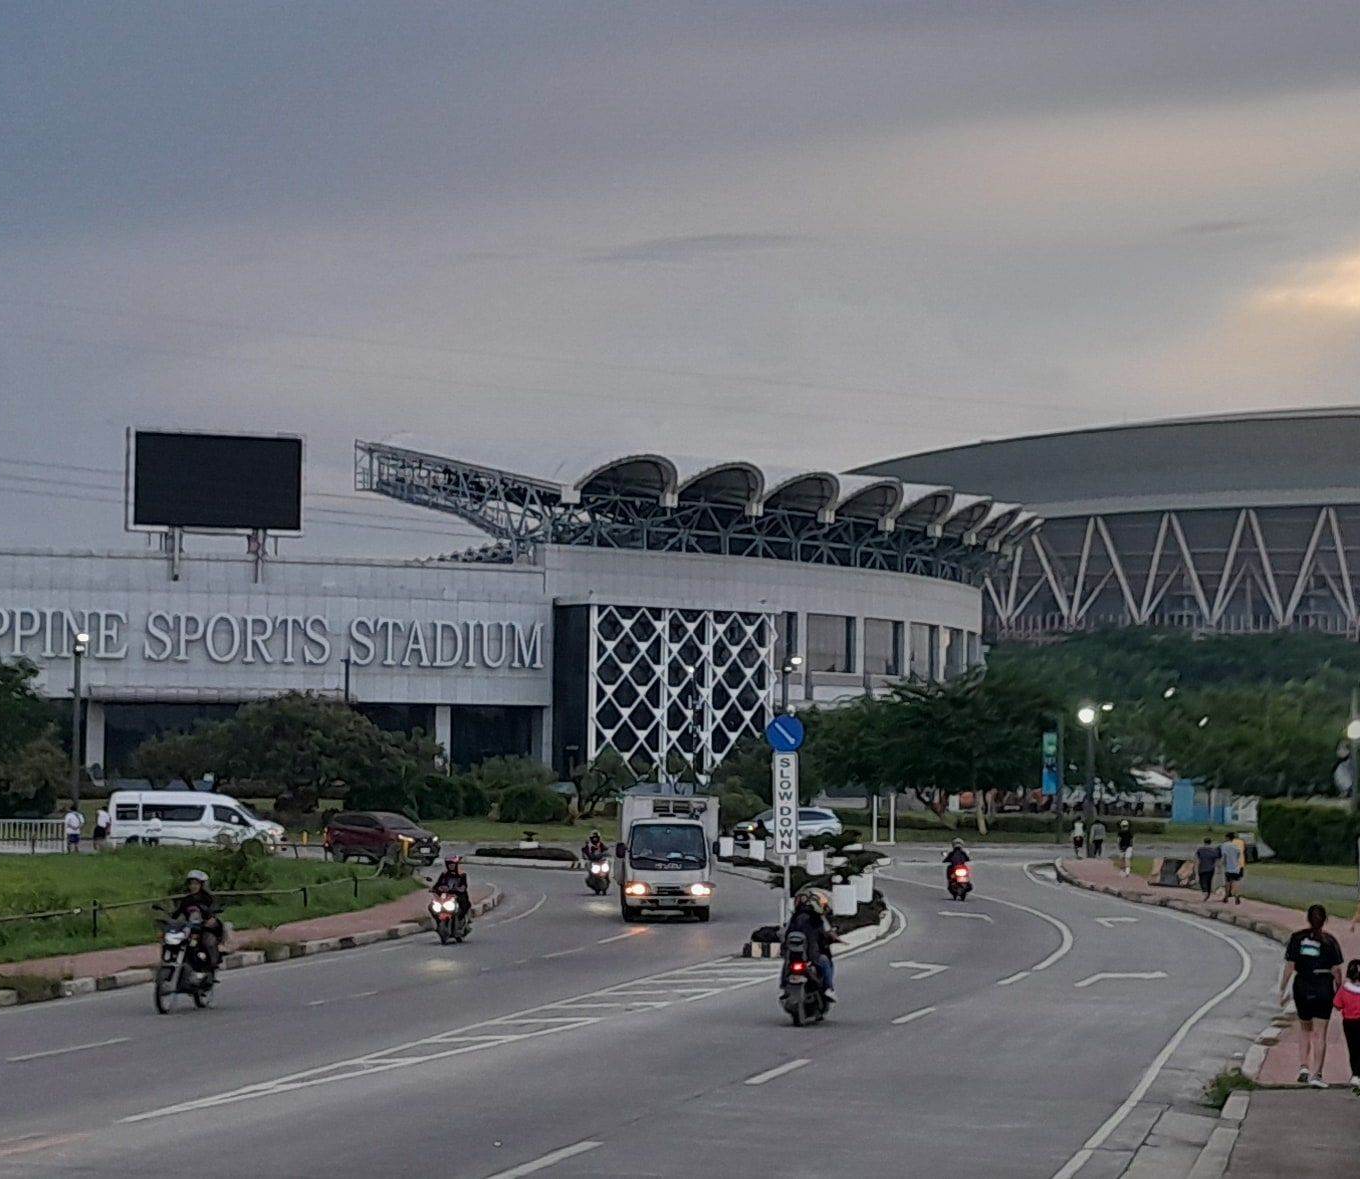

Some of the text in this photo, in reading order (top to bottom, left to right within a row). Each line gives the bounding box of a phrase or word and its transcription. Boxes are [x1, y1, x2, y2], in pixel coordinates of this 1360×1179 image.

[144, 610, 331, 665] SPORTS
[348, 616, 544, 669] STADIUM
[778, 757, 794, 850] SLOW DOWN
